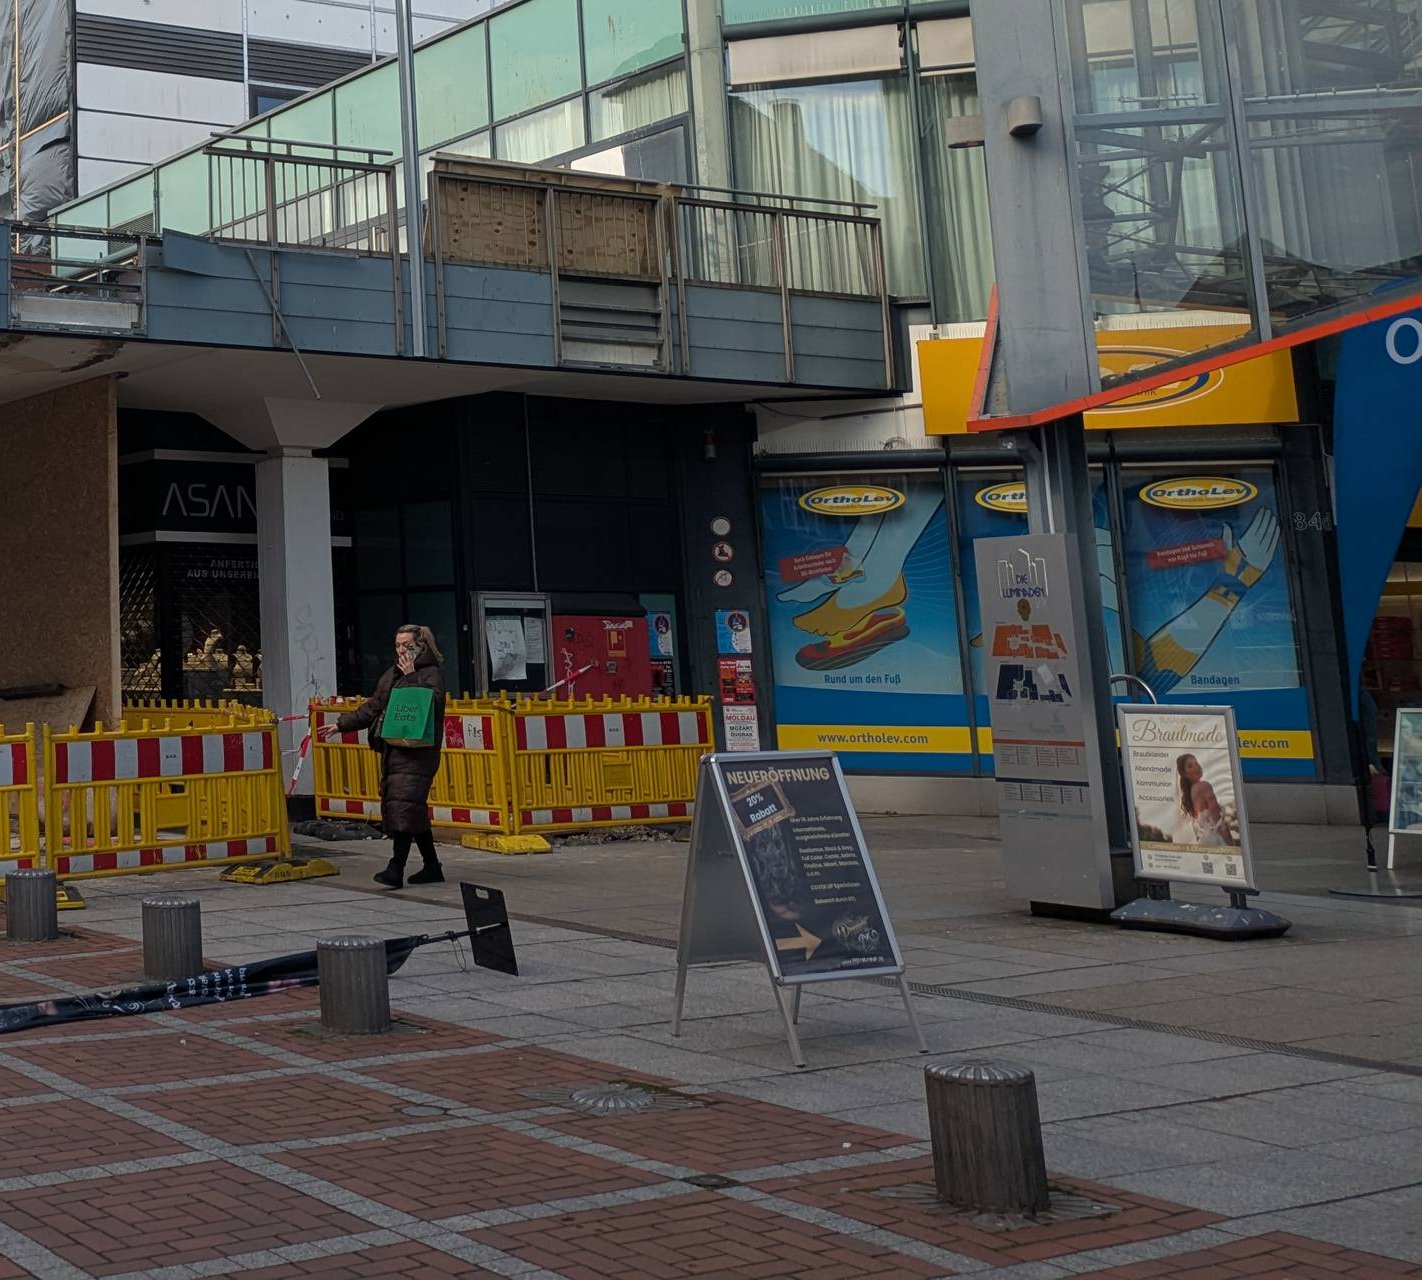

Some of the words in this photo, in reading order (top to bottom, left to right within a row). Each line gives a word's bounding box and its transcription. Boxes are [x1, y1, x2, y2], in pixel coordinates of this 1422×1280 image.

[1152, 486, 1245, 497] OrthoLev
[810, 493, 897, 504] OrthoLev
[824, 674, 847, 684] Rund
[849, 676, 863, 684] um
[865, 674, 882, 684] den
[885, 674, 901, 685] Fuß
[1190, 675, 1240, 686] Bandagen
[1132, 719, 1223, 743] Brautmode
[817, 732, 929, 745] www.ortholev.com
[726, 767, 830, 785] NEUERÖFFNUNG
[746, 793, 764, 807] 20%
[749, 803, 778, 823] Rabatt
